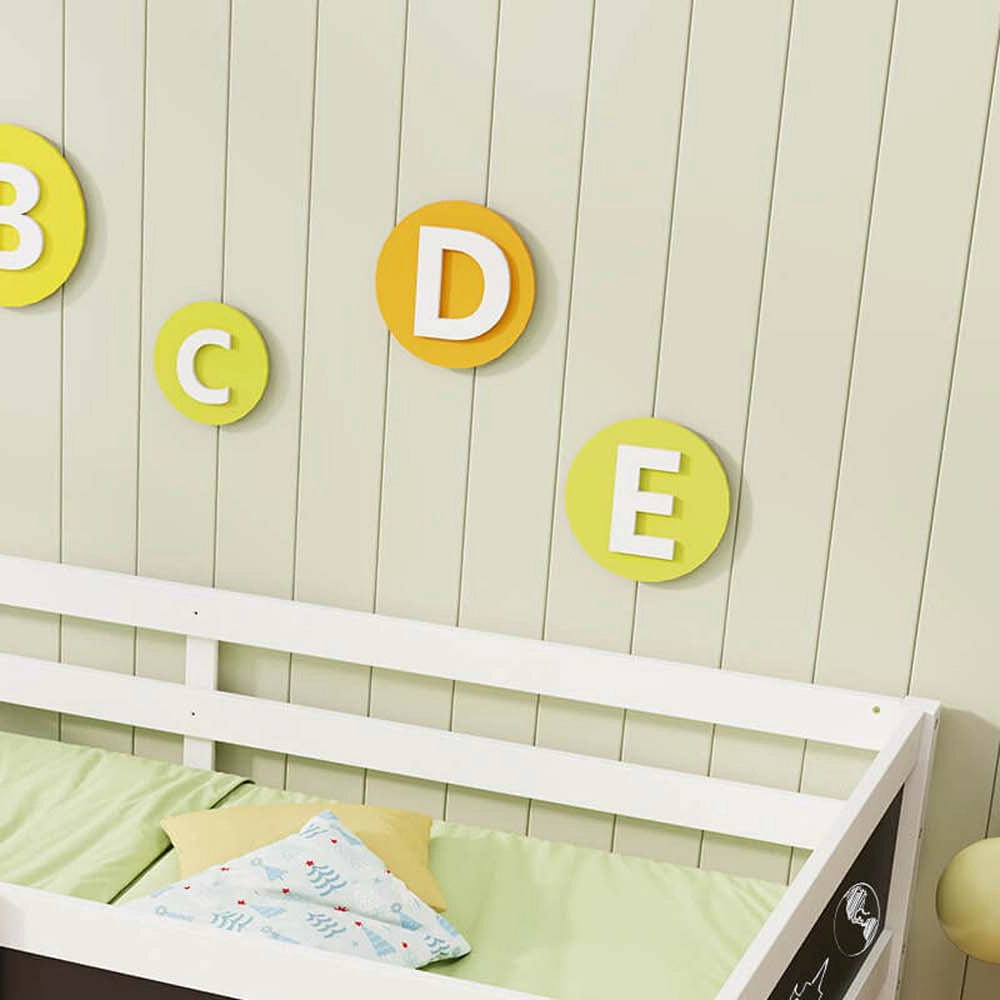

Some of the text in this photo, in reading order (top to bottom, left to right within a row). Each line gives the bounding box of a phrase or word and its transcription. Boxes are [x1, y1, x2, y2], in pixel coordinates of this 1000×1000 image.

[413, 223, 512, 341] D
[175, 328, 234, 405] C
[608, 444, 682, 559] E
